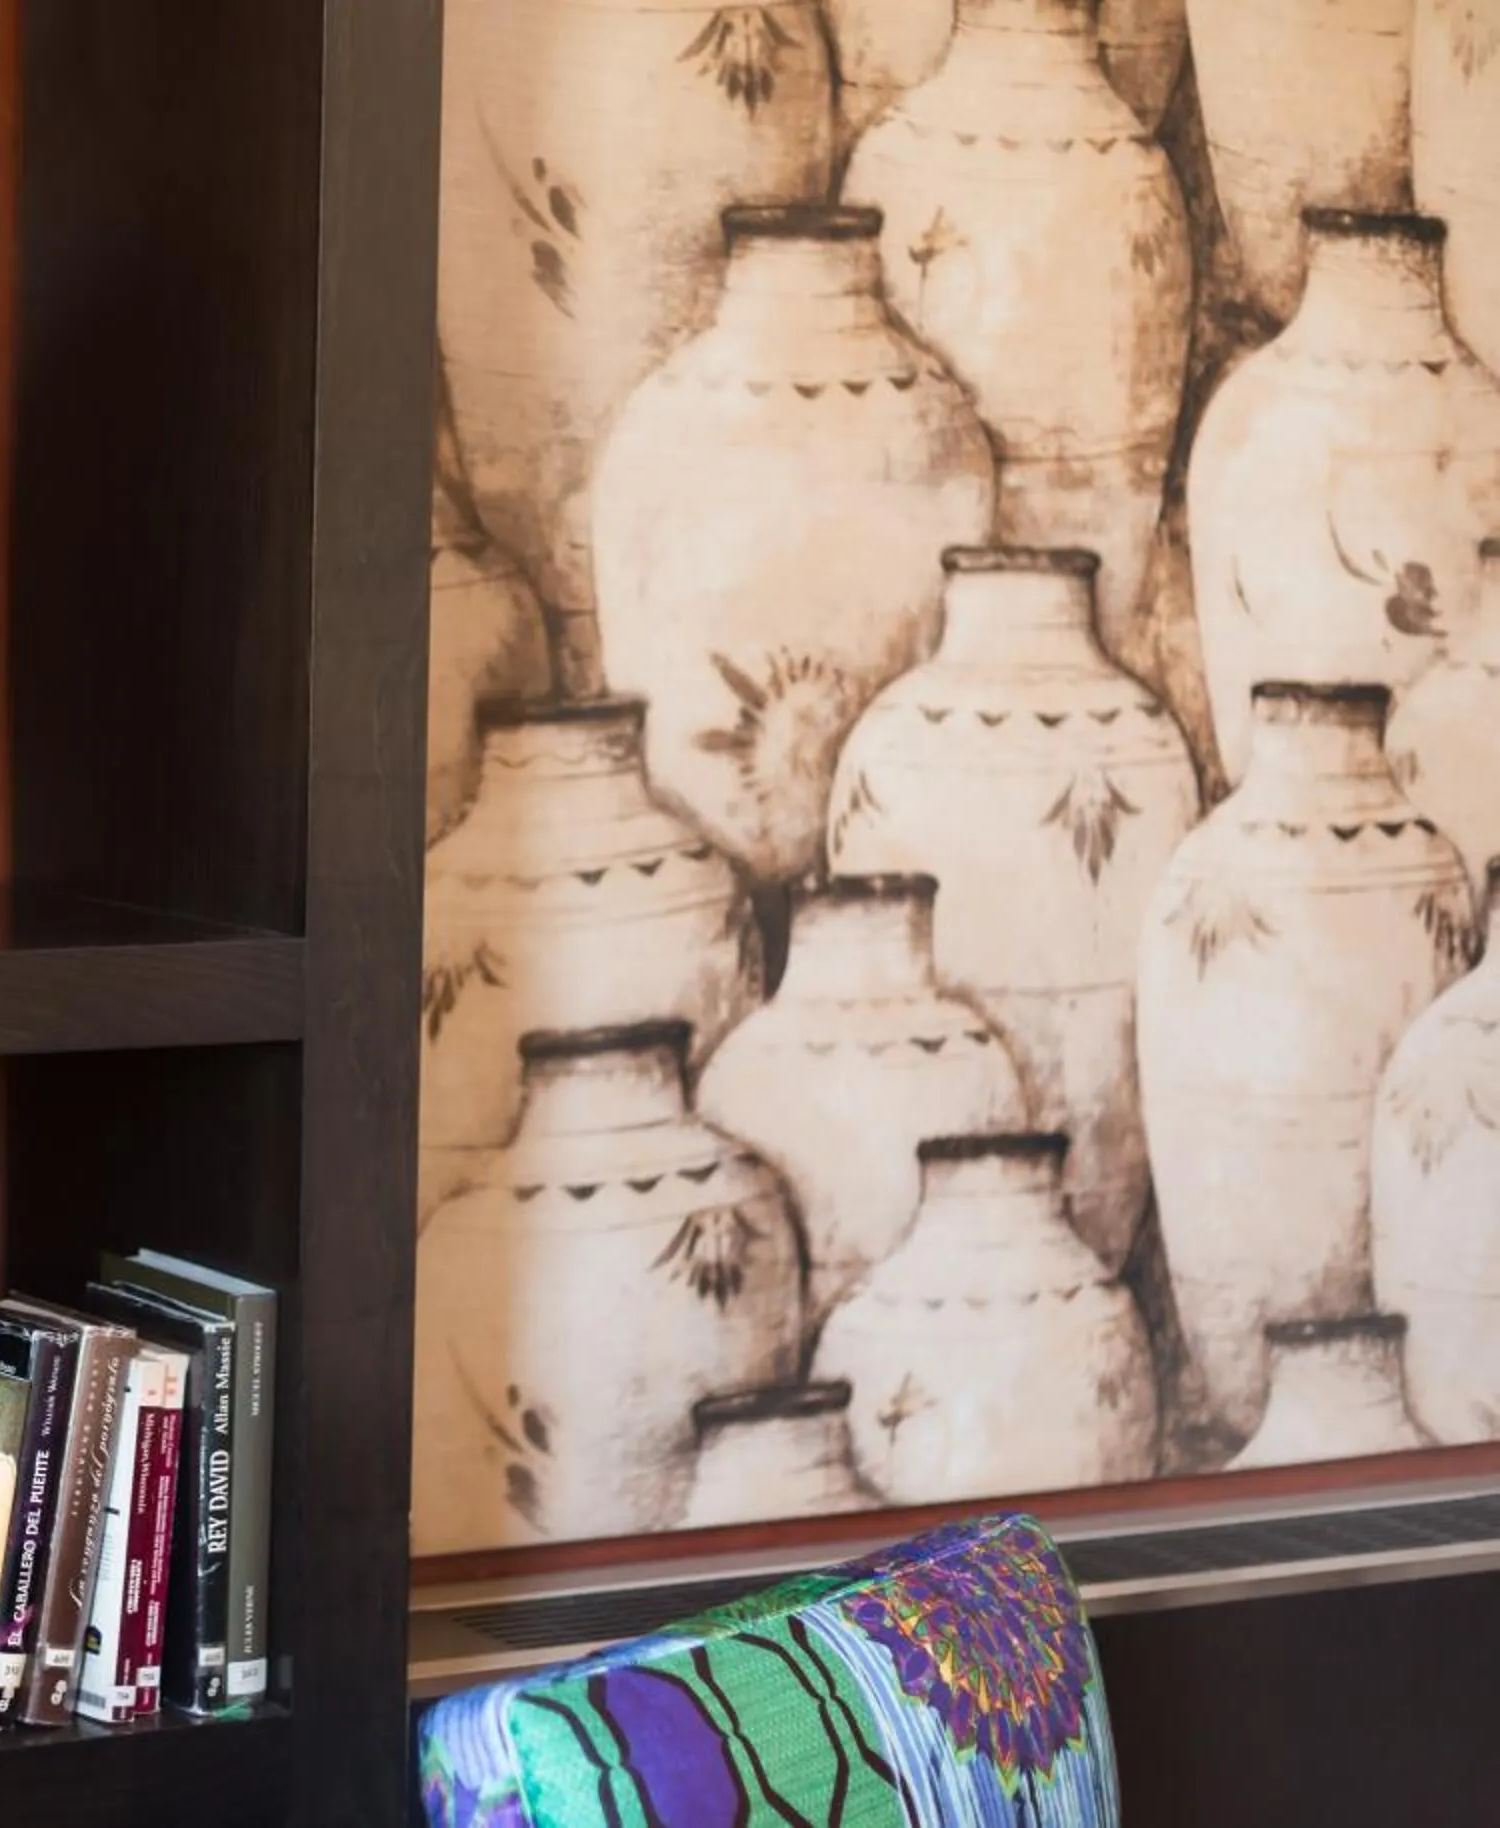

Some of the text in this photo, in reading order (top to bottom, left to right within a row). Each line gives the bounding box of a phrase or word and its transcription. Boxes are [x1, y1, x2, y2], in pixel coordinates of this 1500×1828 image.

[213, 1337, 231, 1435] Allan Massie
[90, 1444, 104, 1489] del
[207, 1450, 230, 1553] REY DAVID
[8, 1450, 49, 1647] EL CABALLERO DEL PUENTE
